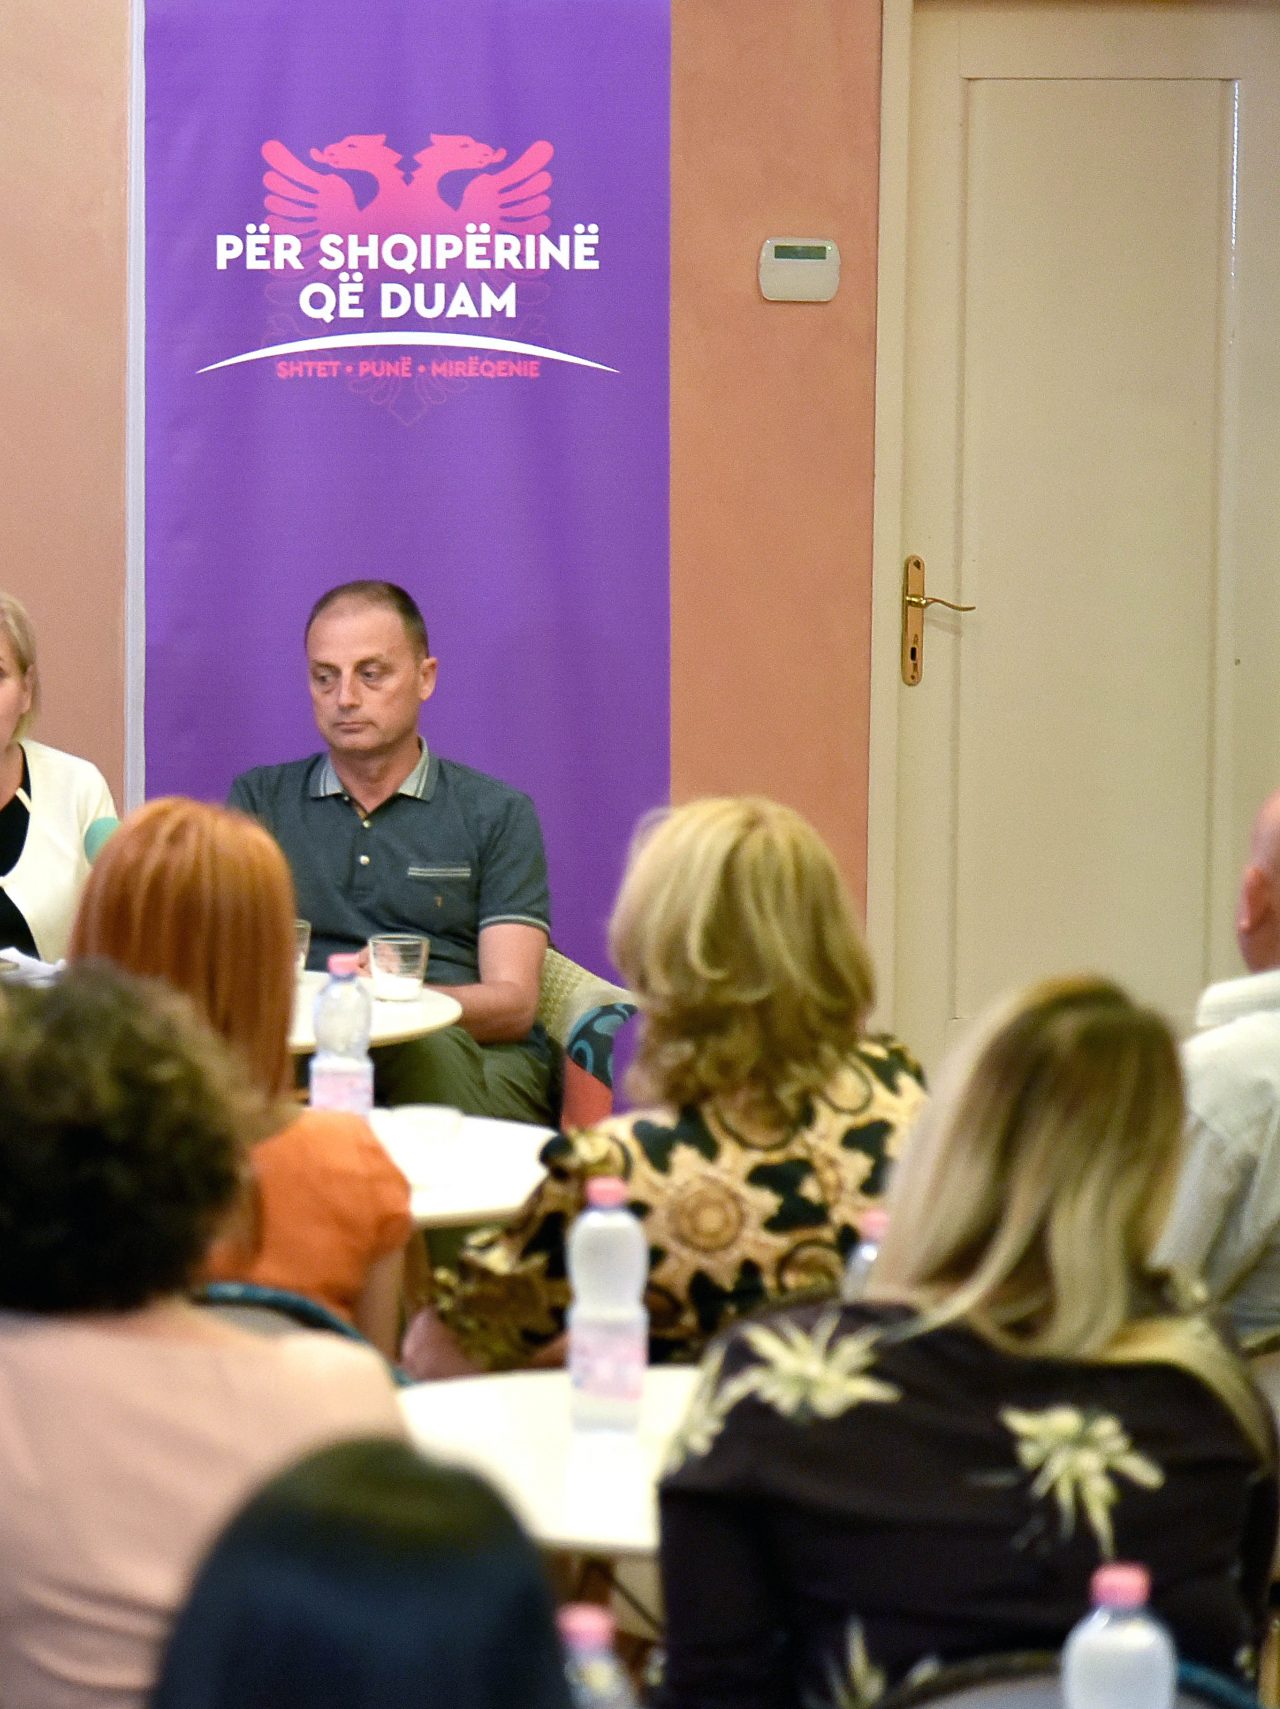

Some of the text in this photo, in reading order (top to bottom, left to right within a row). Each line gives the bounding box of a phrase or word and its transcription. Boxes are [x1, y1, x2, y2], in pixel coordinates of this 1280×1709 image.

[216, 222, 600, 274] PËR SHQIPËRINË
[299, 272, 517, 323] QË DUAM
[277, 360, 339, 378] SHTET
[359, 356, 412, 378] PUNË
